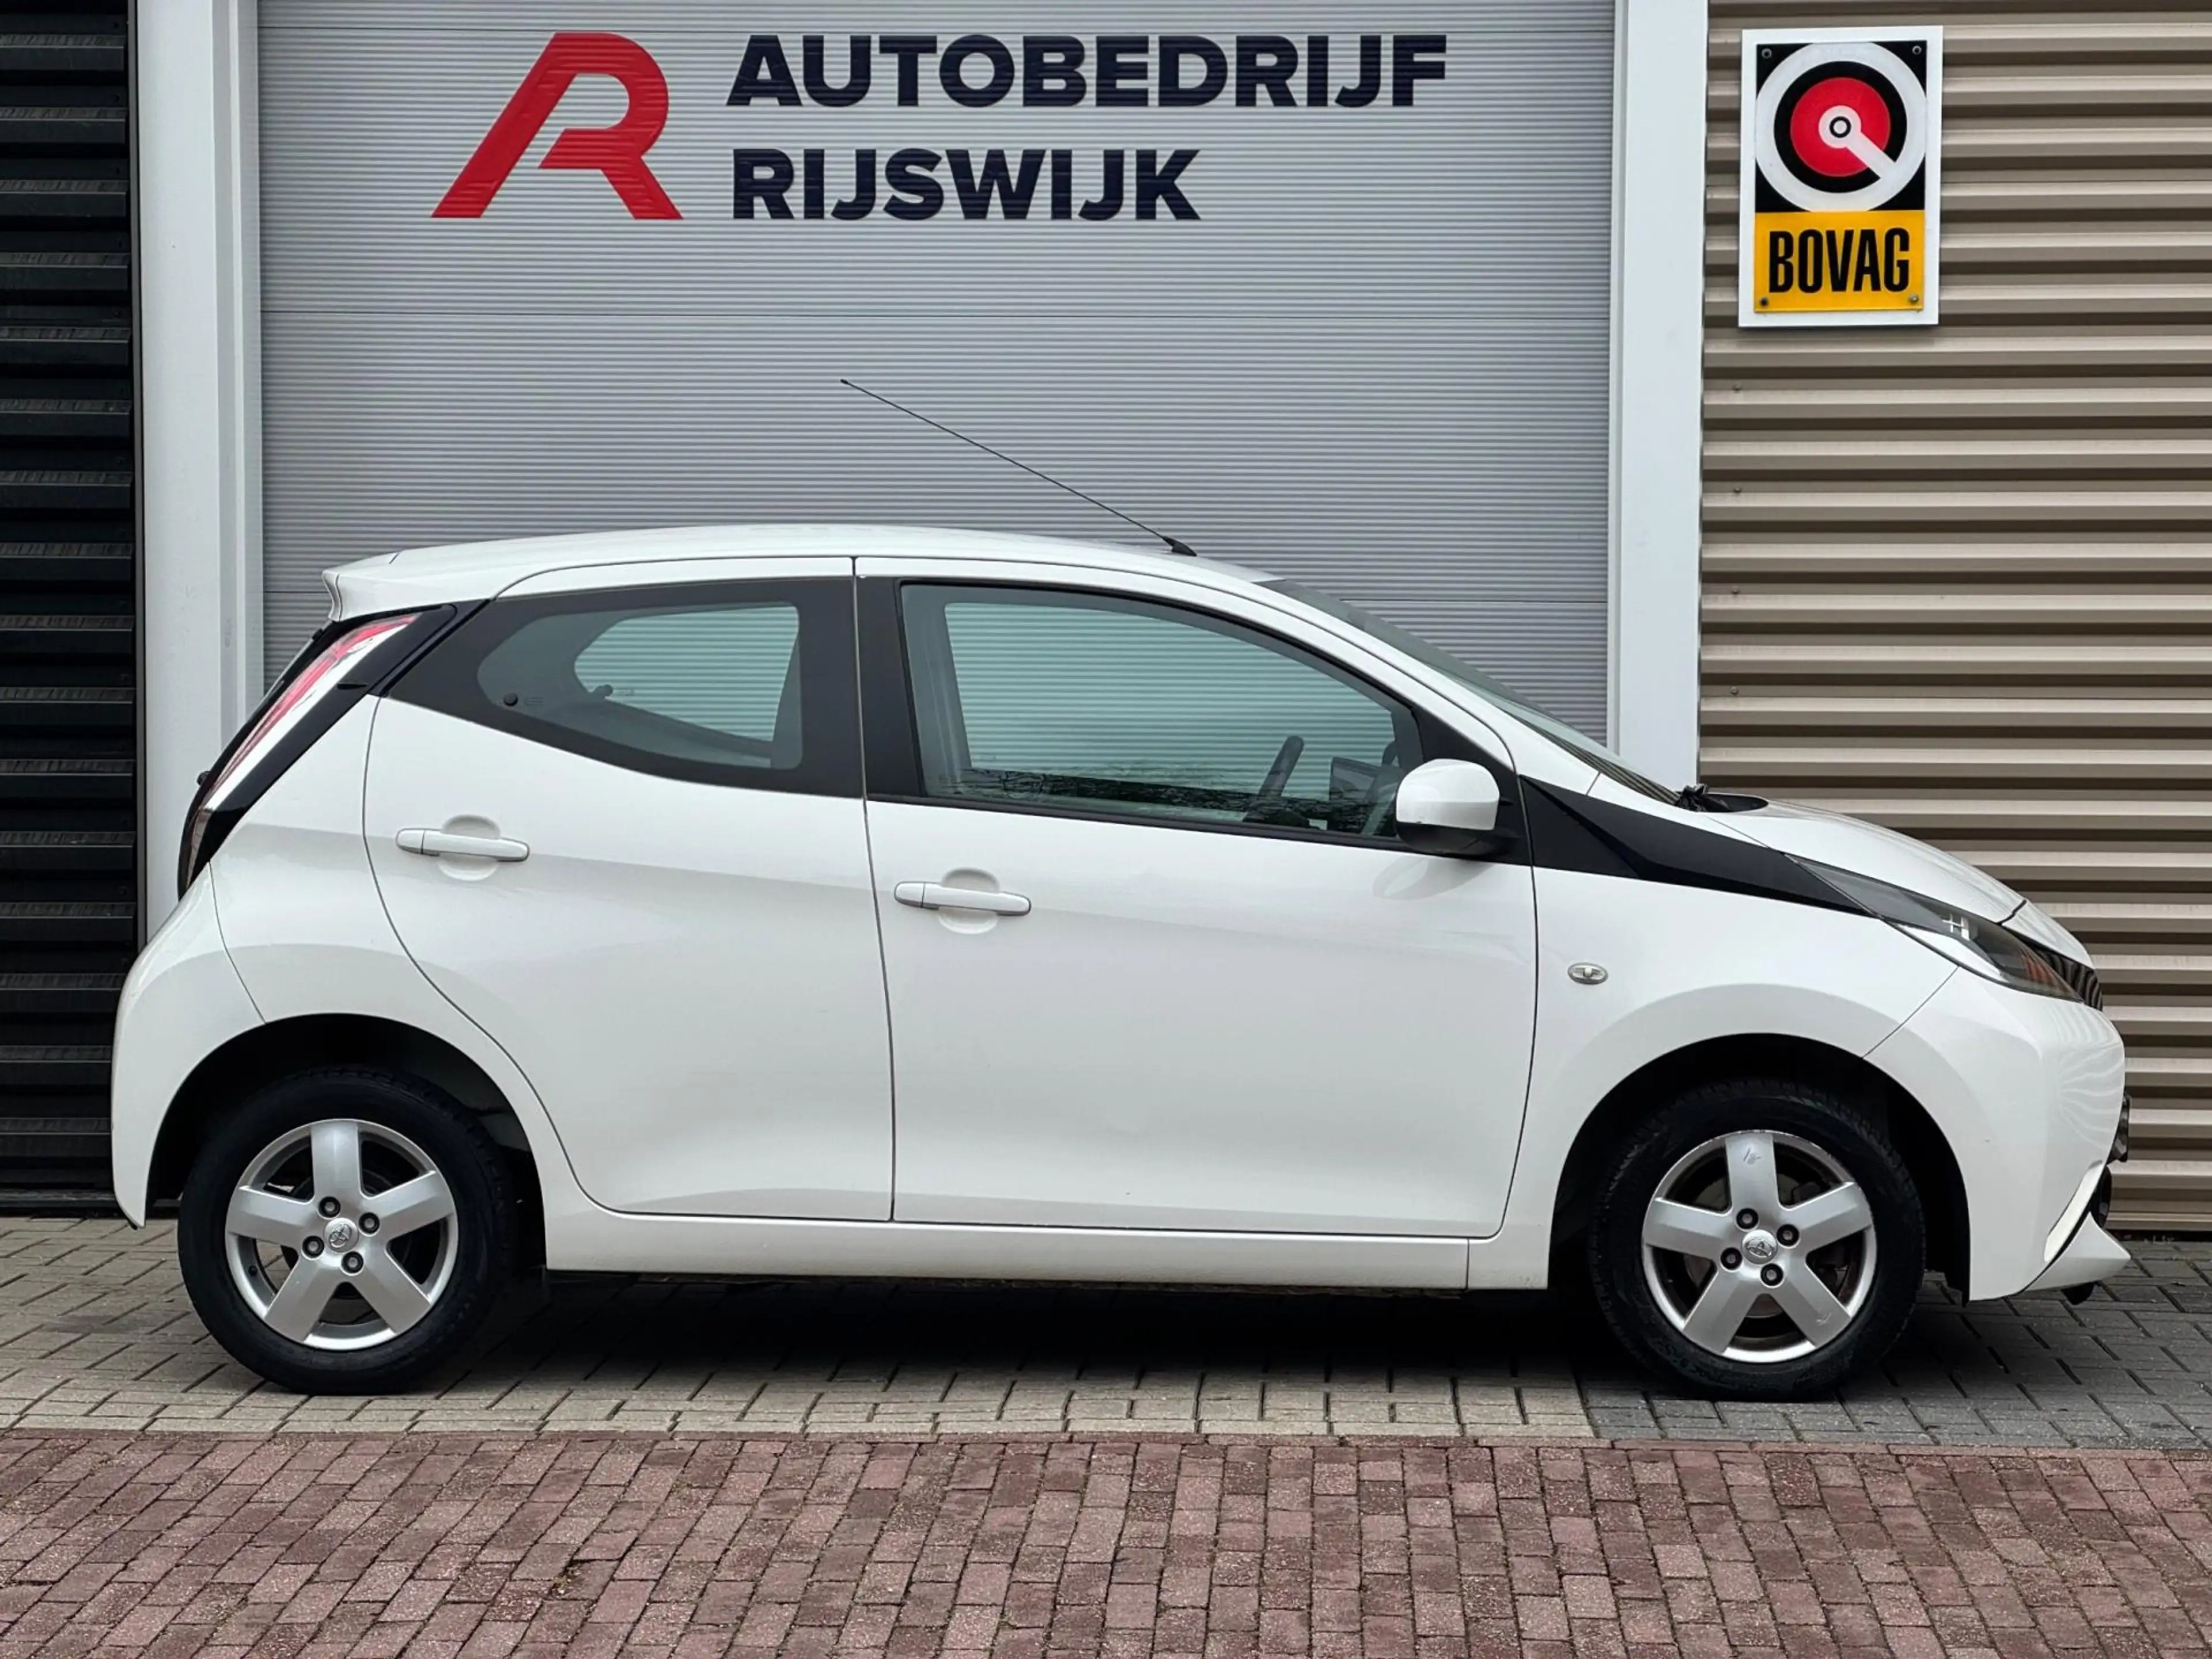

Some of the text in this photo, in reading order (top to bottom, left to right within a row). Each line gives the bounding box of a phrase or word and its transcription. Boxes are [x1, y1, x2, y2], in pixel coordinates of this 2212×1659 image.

[726, 33, 1447, 108] AUTOBEDRIJF
[733, 147, 1201, 221] RIJSWIJK
[1768, 227, 1910, 293] BOVAG
